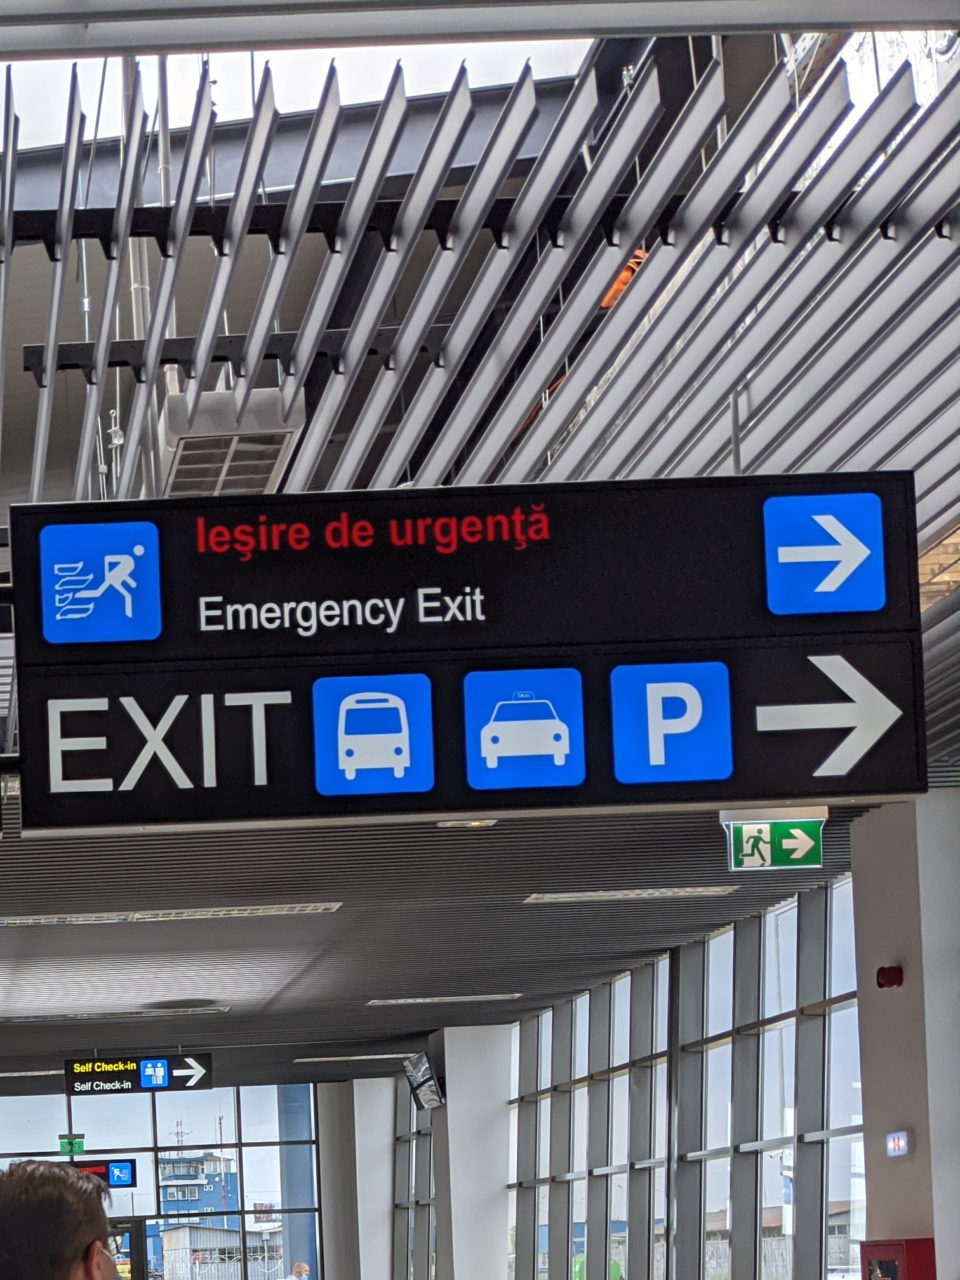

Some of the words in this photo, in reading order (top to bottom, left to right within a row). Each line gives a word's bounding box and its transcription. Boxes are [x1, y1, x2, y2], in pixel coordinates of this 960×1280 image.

[324, 511, 375, 549] de
[199, 595, 406, 637] Emergency
[417, 586, 486, 623] Exit
[47, 690, 292, 793] EXIT
[646, 682, 703, 765] P
[73, 1063, 92, 1073] Self
[94, 1061, 137, 1072] Check-in
[74, 1081, 91, 1091] Self
[93, 1080, 131, 1090] Check-in
